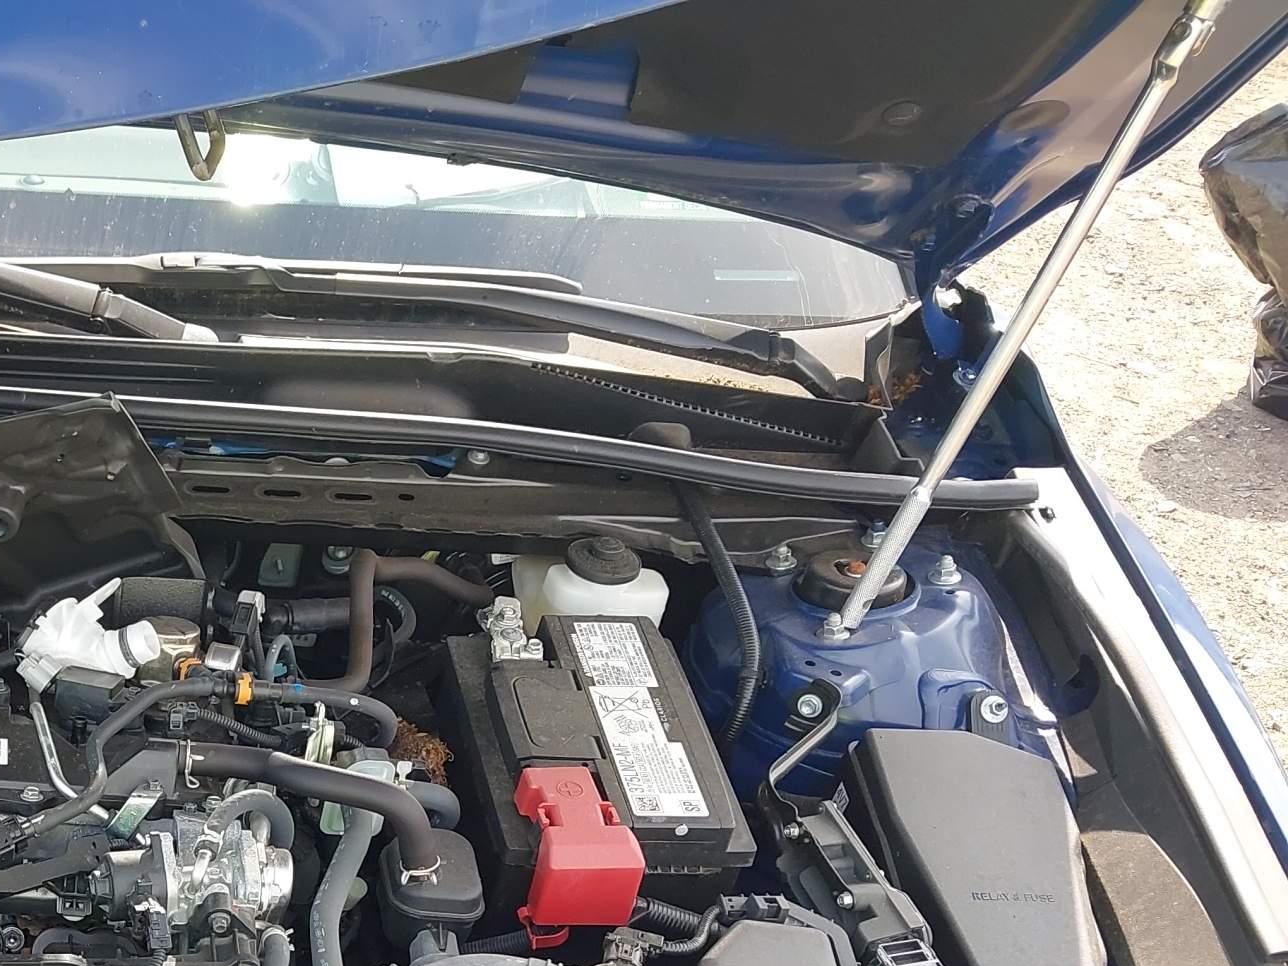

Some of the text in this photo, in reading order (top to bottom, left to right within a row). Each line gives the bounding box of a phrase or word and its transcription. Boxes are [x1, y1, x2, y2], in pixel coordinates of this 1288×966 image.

[612, 743, 645, 794] 375LN2-MF
[683, 801, 701, 812] SP
[971, 891, 1056, 903] RELAY & FUSE
